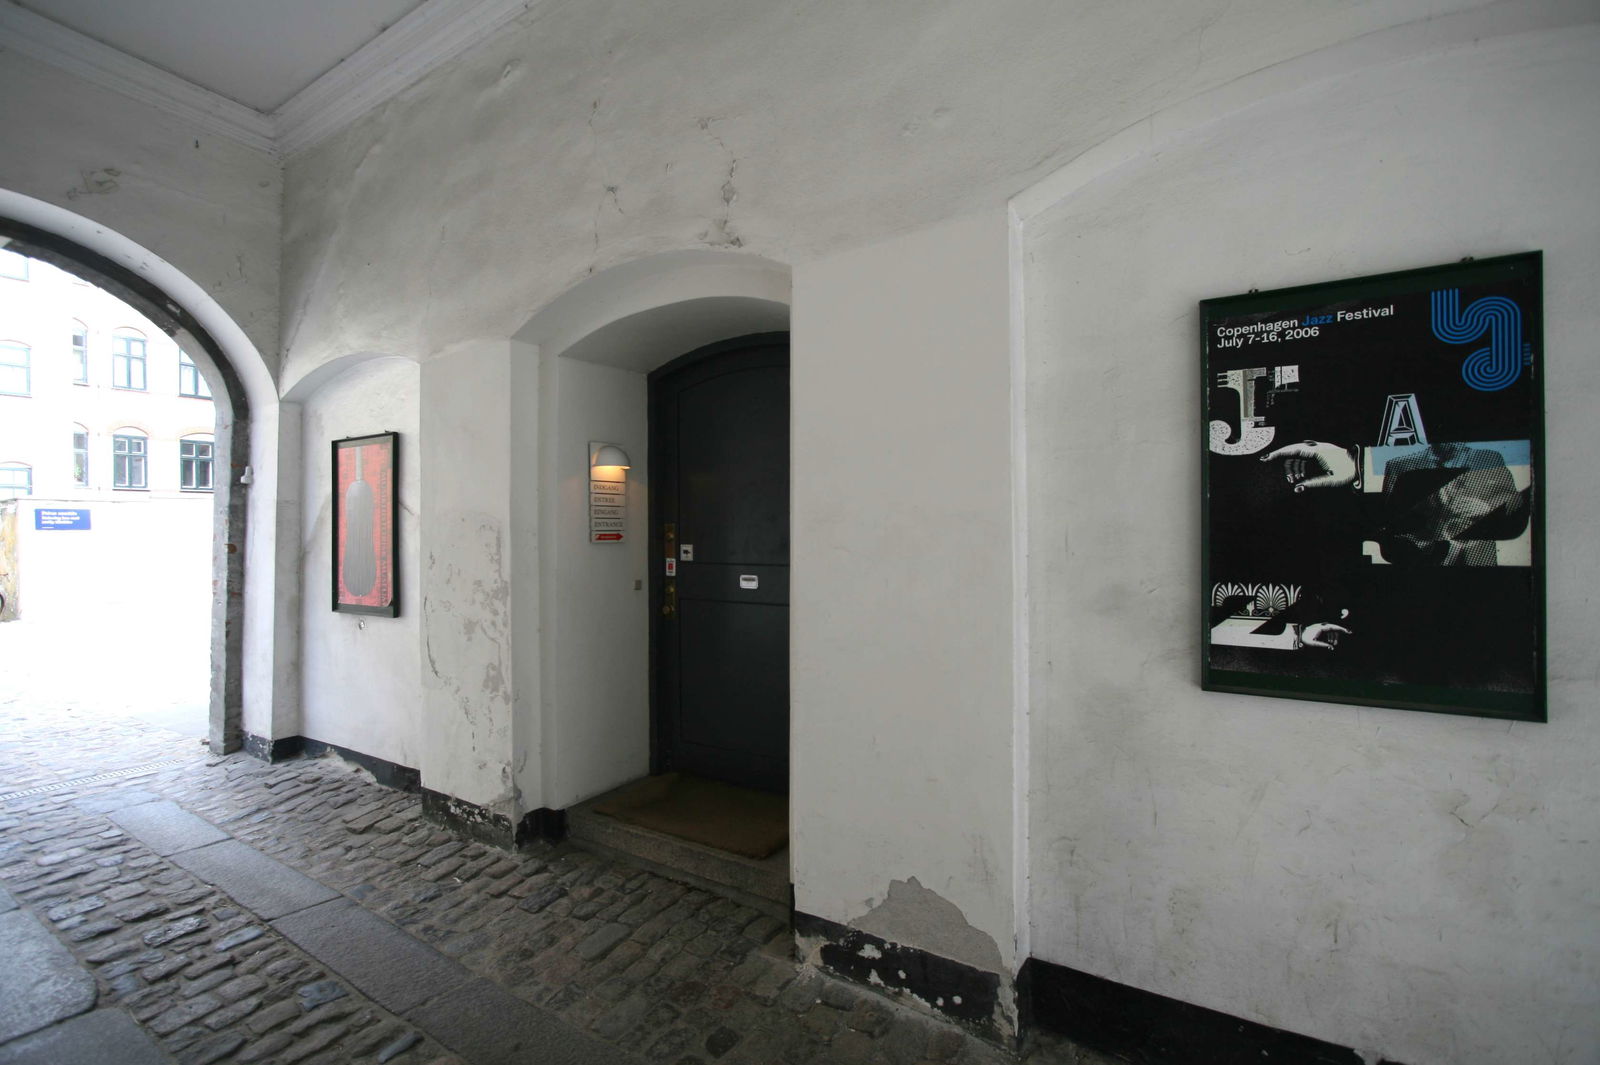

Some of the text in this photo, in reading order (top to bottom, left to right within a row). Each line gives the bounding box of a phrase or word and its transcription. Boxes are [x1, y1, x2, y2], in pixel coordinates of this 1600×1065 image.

[1217, 304, 1394, 338] Copenhagen Jazz Festival
[1216, 326, 1320, 349] July 7-16, 2006
[593, 484, 619, 492] INDGANG
[594, 520, 624, 528] ENTRANCE
